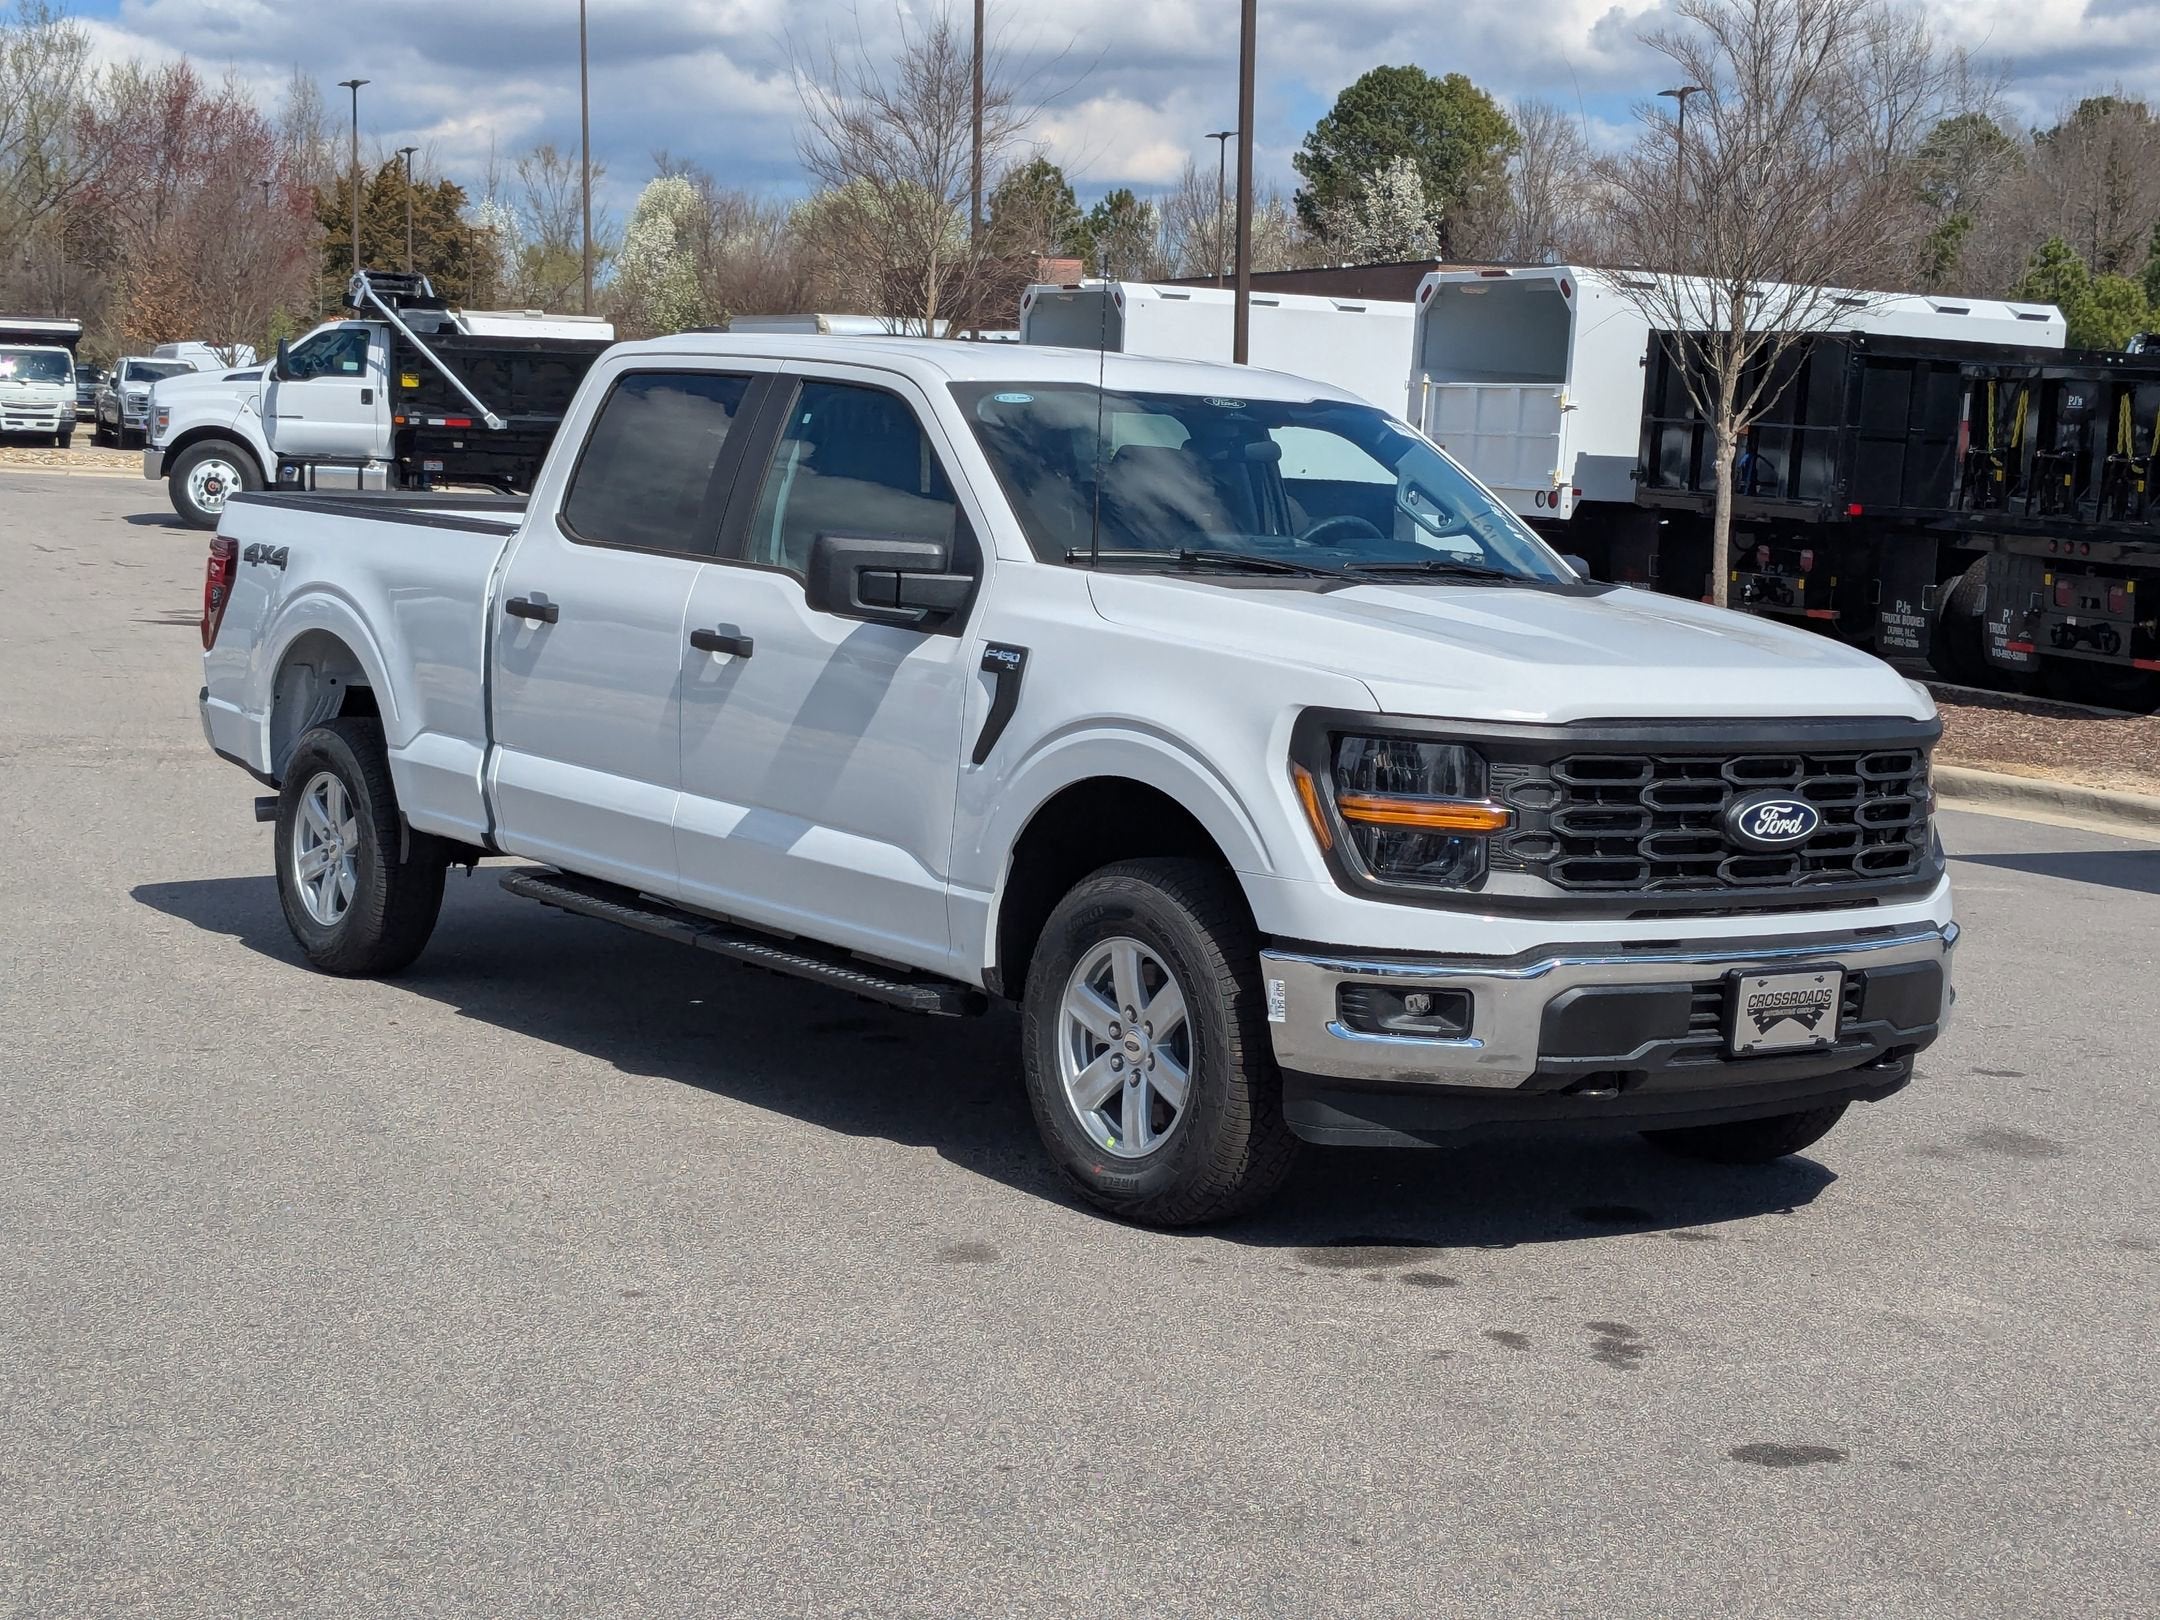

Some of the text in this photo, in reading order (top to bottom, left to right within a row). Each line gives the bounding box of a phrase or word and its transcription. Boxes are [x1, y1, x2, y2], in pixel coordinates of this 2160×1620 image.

[1881, 611, 1926, 628] TRUCK BODIES
[1754, 805, 1804, 835] Ford
[1748, 989, 1832, 1008] CROSSROADS
